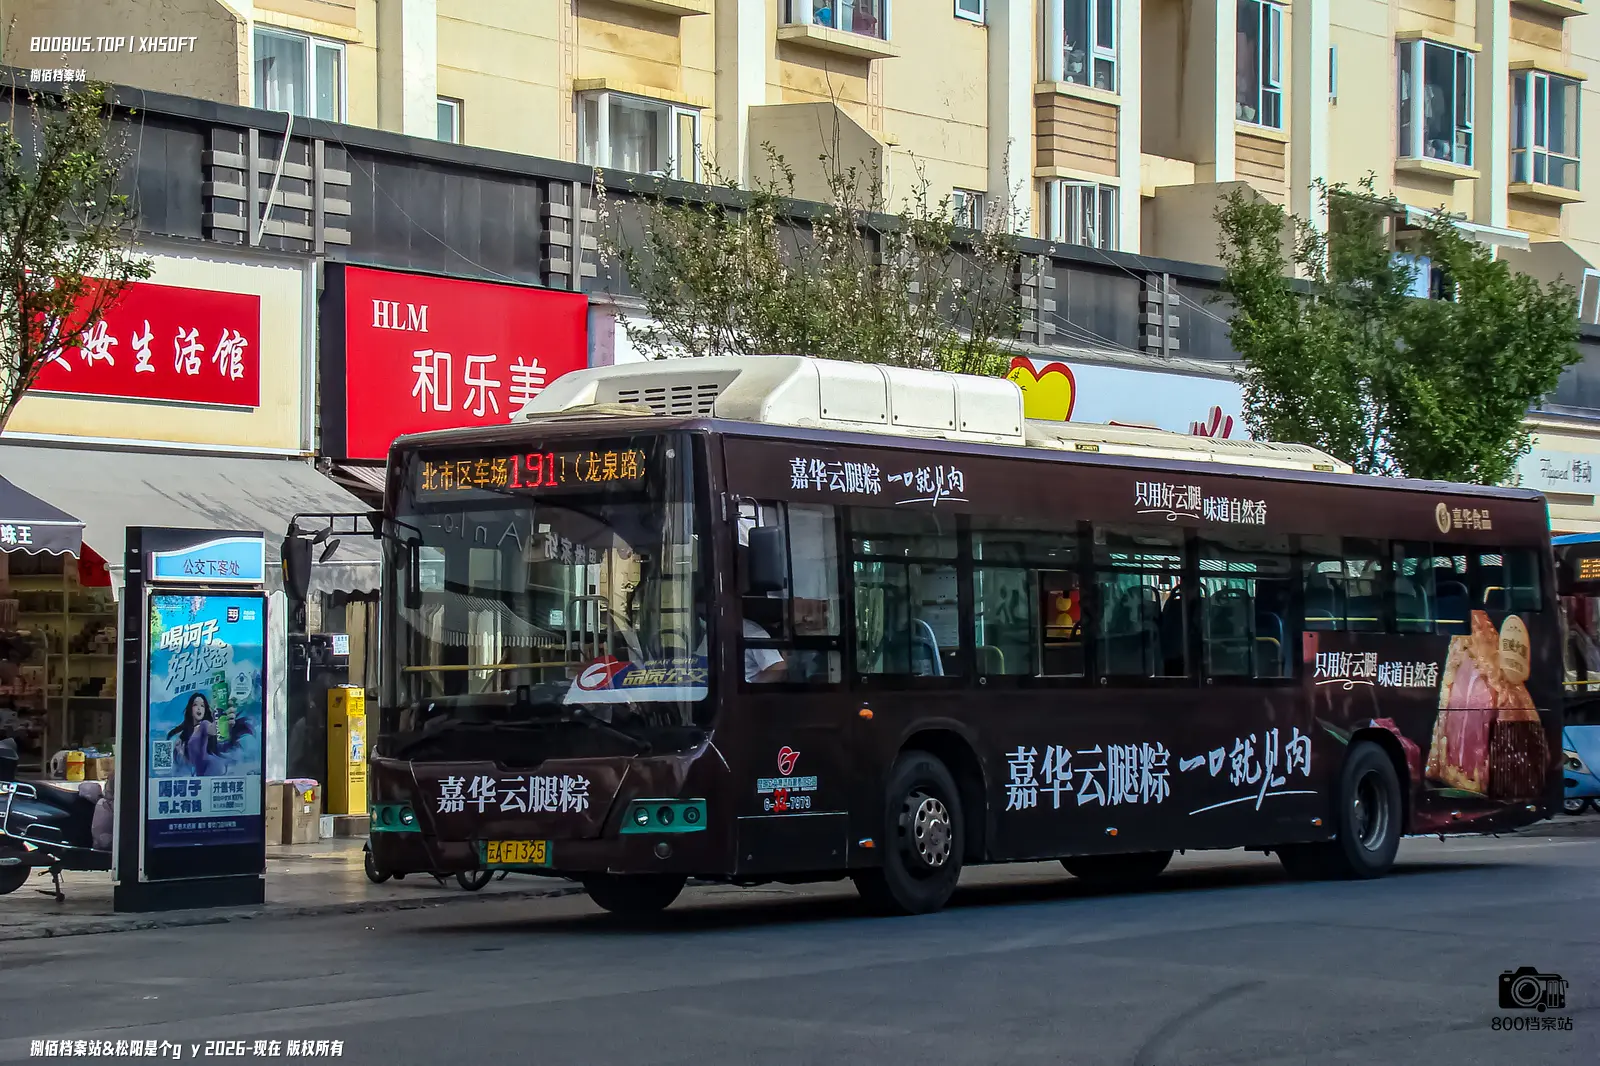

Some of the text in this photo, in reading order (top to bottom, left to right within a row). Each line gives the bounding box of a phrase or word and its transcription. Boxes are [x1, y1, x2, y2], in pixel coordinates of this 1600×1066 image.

[371, 299, 428, 333] HLM
[411, 349, 547, 421] 和乐美
[422, 457, 508, 490] 北市区车场
[509, 453, 558, 488] 191
[789, 457, 964, 507] 嘉华云腿粽 一口就见肉
[1135, 481, 1267, 525] 只用好云腿 味道自然香
[183, 559, 240, 576] 公交下客处
[623, 668, 708, 686] 品质公交
[1313, 652, 1439, 688] 只用好云腿 味道自然香
[1004, 727, 1312, 811] 嘉华云腿粽 一口就见肉
[436, 775, 591, 813] 嘉华云腿粽
